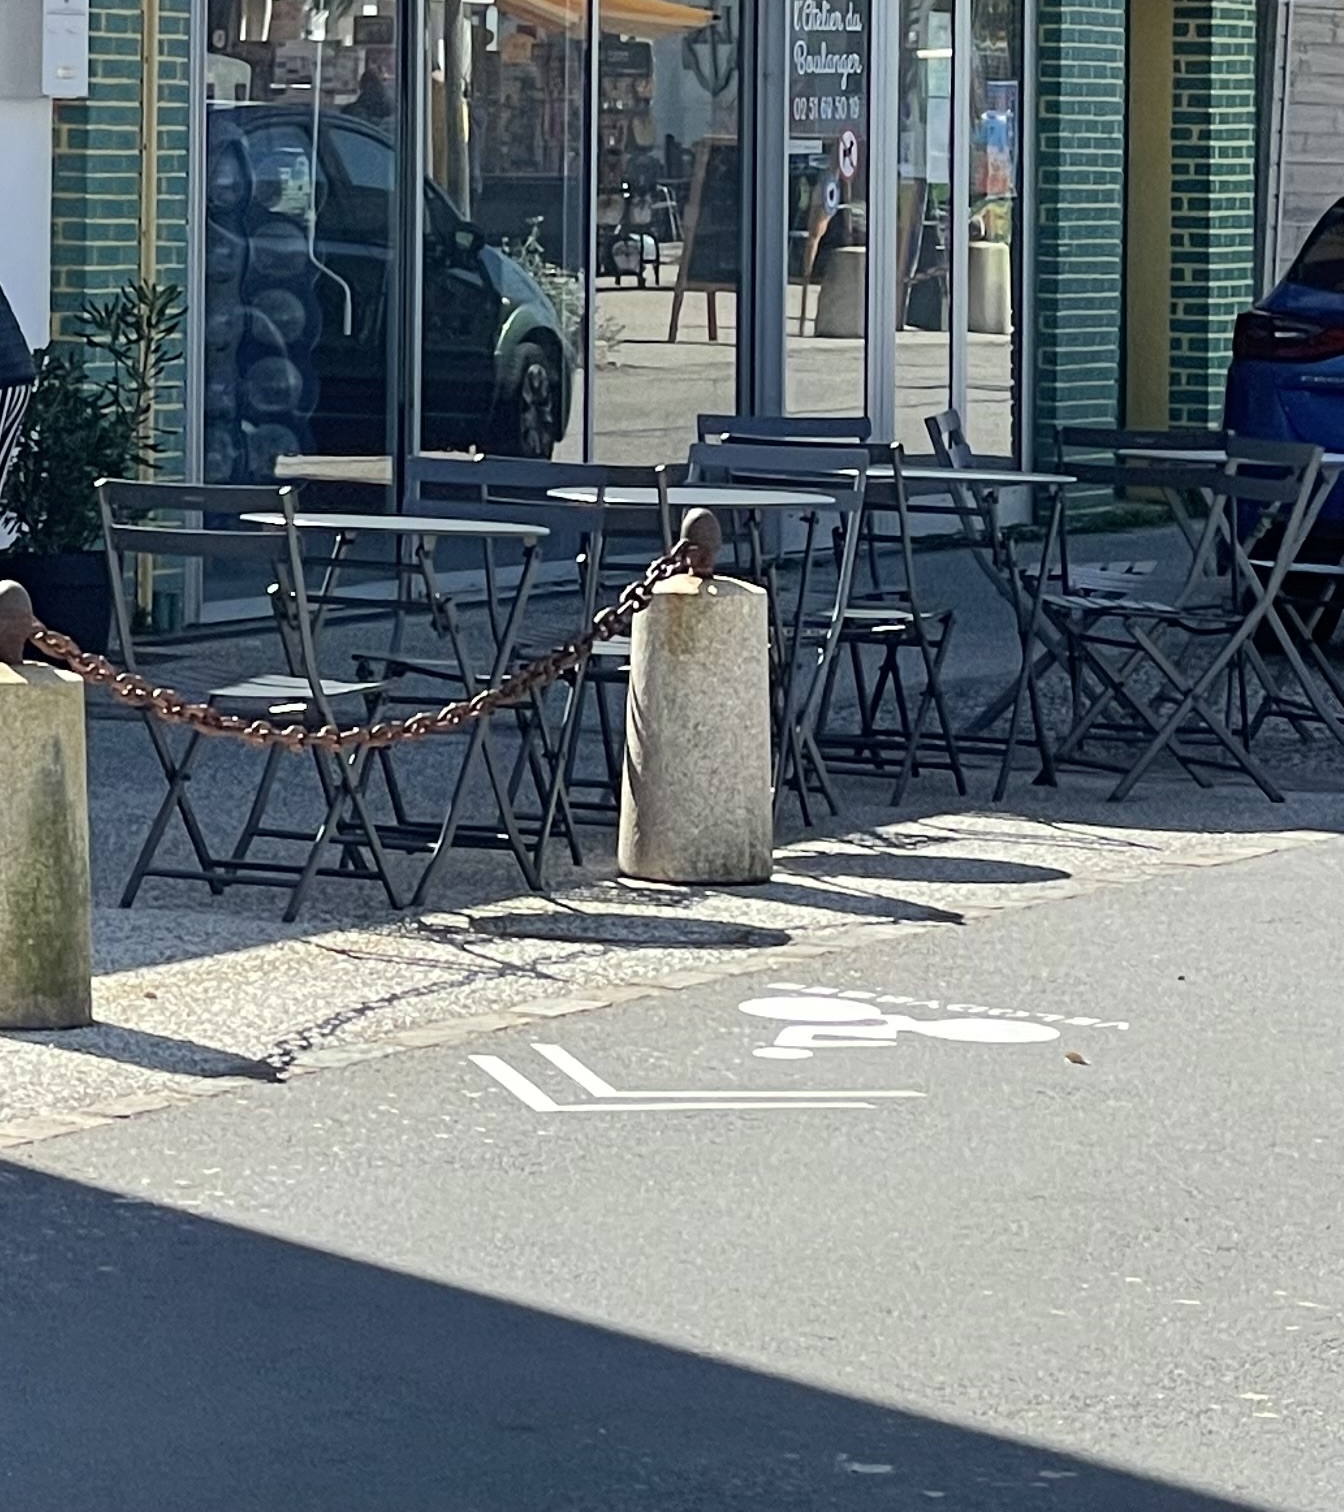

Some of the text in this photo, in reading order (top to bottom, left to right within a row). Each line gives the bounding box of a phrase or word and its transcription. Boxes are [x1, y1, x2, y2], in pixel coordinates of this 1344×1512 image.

[793, 40, 863, 90] Boulanger
[793, 96, 807, 120] 02
[808, 96, 819, 120] 51
